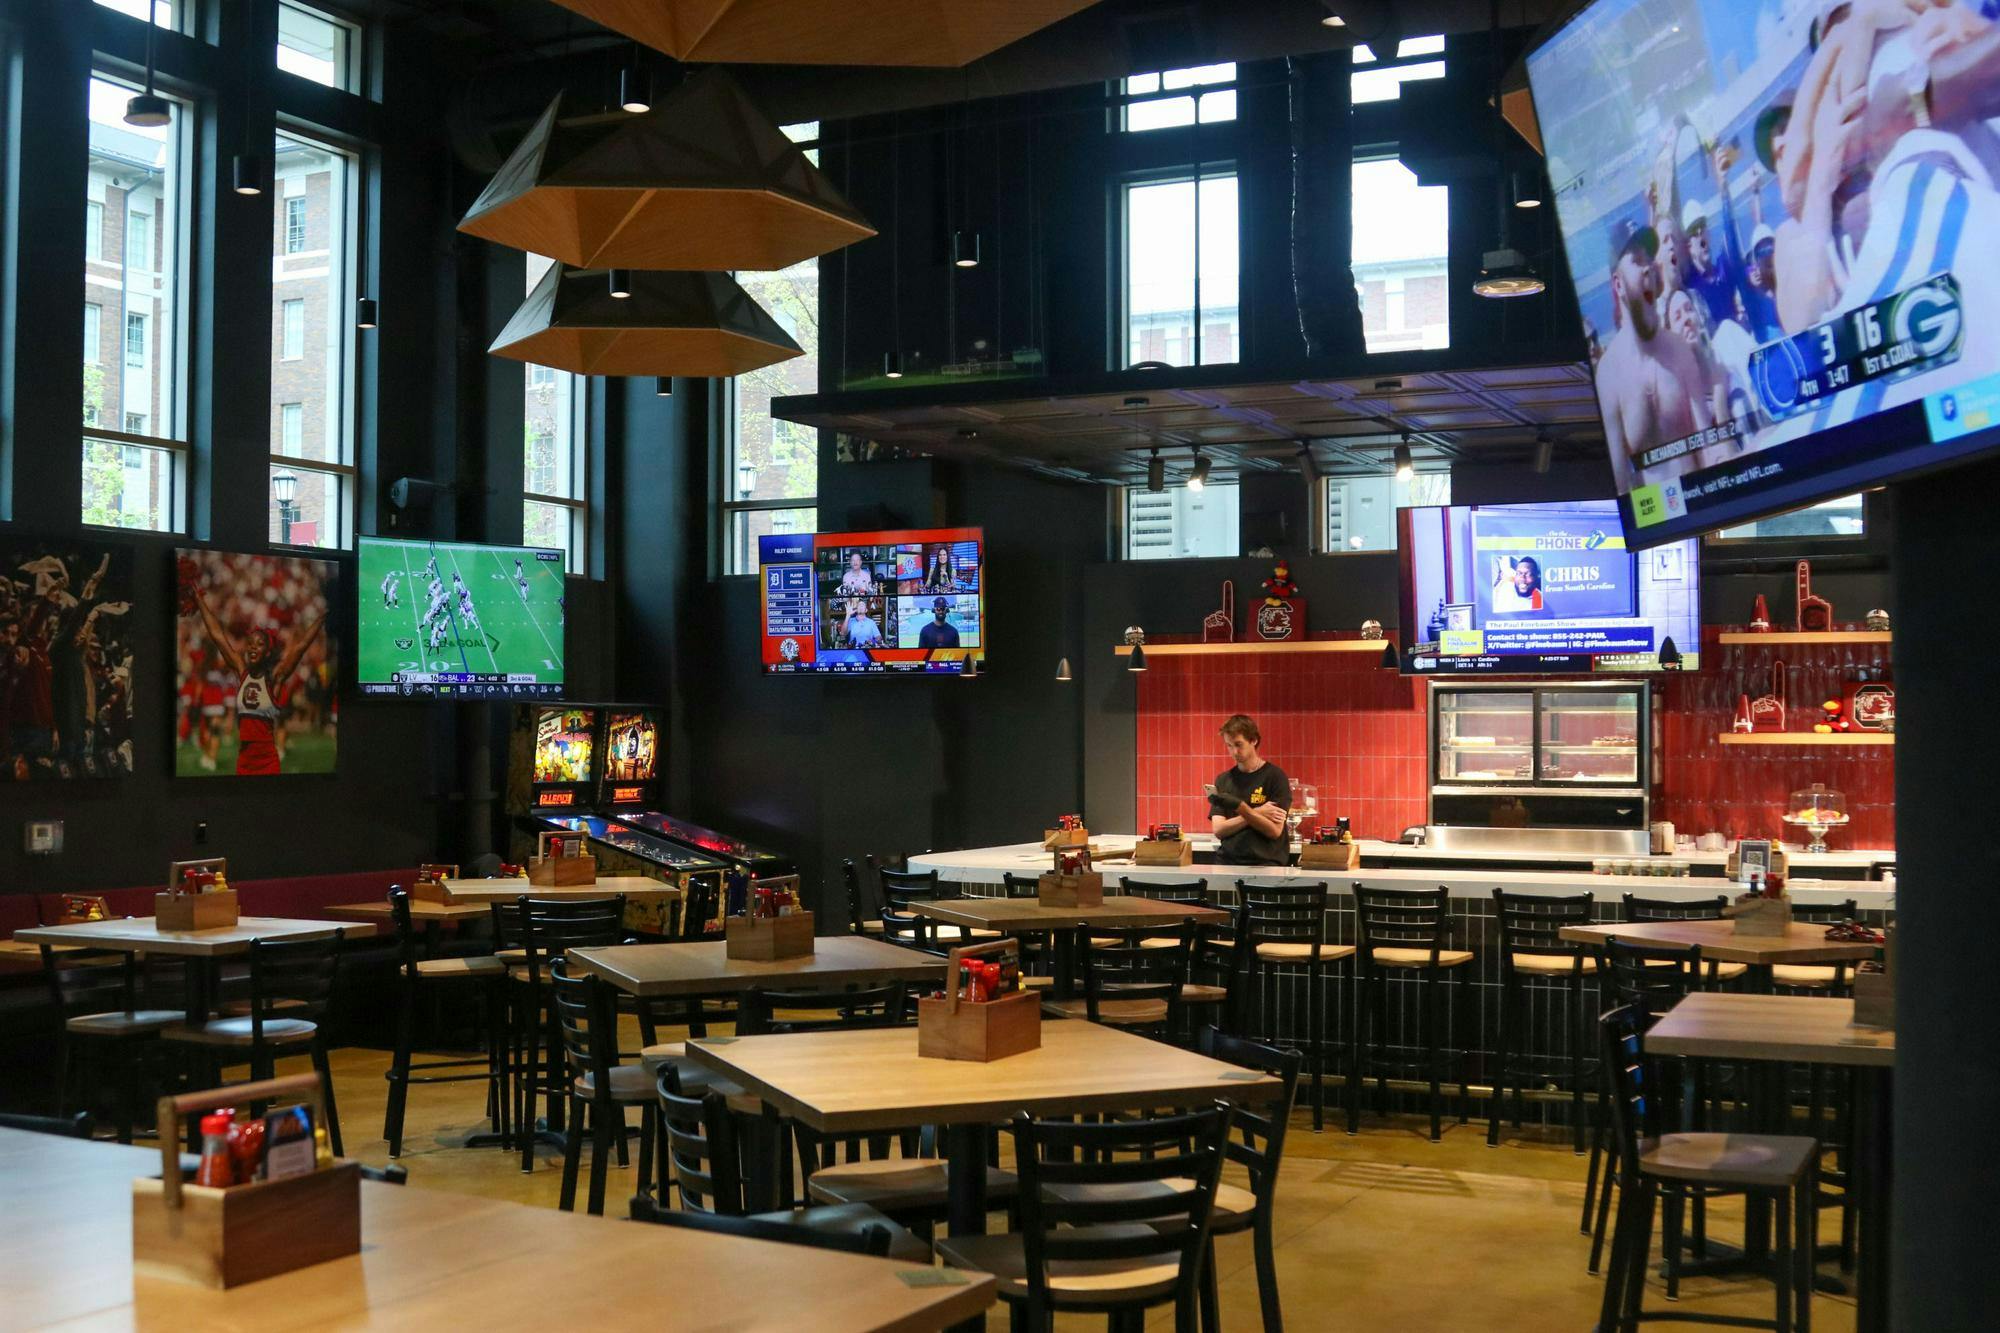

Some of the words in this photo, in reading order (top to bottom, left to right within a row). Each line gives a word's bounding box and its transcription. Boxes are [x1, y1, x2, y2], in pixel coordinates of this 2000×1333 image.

[1854, 306, 1882, 351] 16
[1820, 325, 1837, 365] 3
[1864, 355, 1881, 376] 1ST
[1889, 338, 1918, 367] GOAL
[1827, 364, 1849, 388] 1:47
[1800, 379, 1820, 397] 4TH
[1650, 438, 1688, 463] RICHARDSON
[1735, 470, 1749, 484] and
[1749, 463, 1784, 480] NFL.com.
[1640, 496, 1654, 507] NEWS
[1535, 537, 1582, 549] PHONE
[1544, 565, 1600, 582] CHRIS
[1545, 584, 1563, 593] from
[1564, 583, 1585, 592] South
[1586, 582, 1616, 591] Carolina
[1515, 633, 1528, 641] the
[1529, 632, 1552, 640] show:
[457, 638, 487, 648] GOAL
[1487, 641, 1524, 650] X/Twitter:
[1525, 640, 1568, 650] @Finebaum
[1584, 639, 1649, 649] @FinebaumShow
[430, 674, 438, 682] 16
[448, 674, 459, 682] BAL
[467, 674, 476, 682] 23
